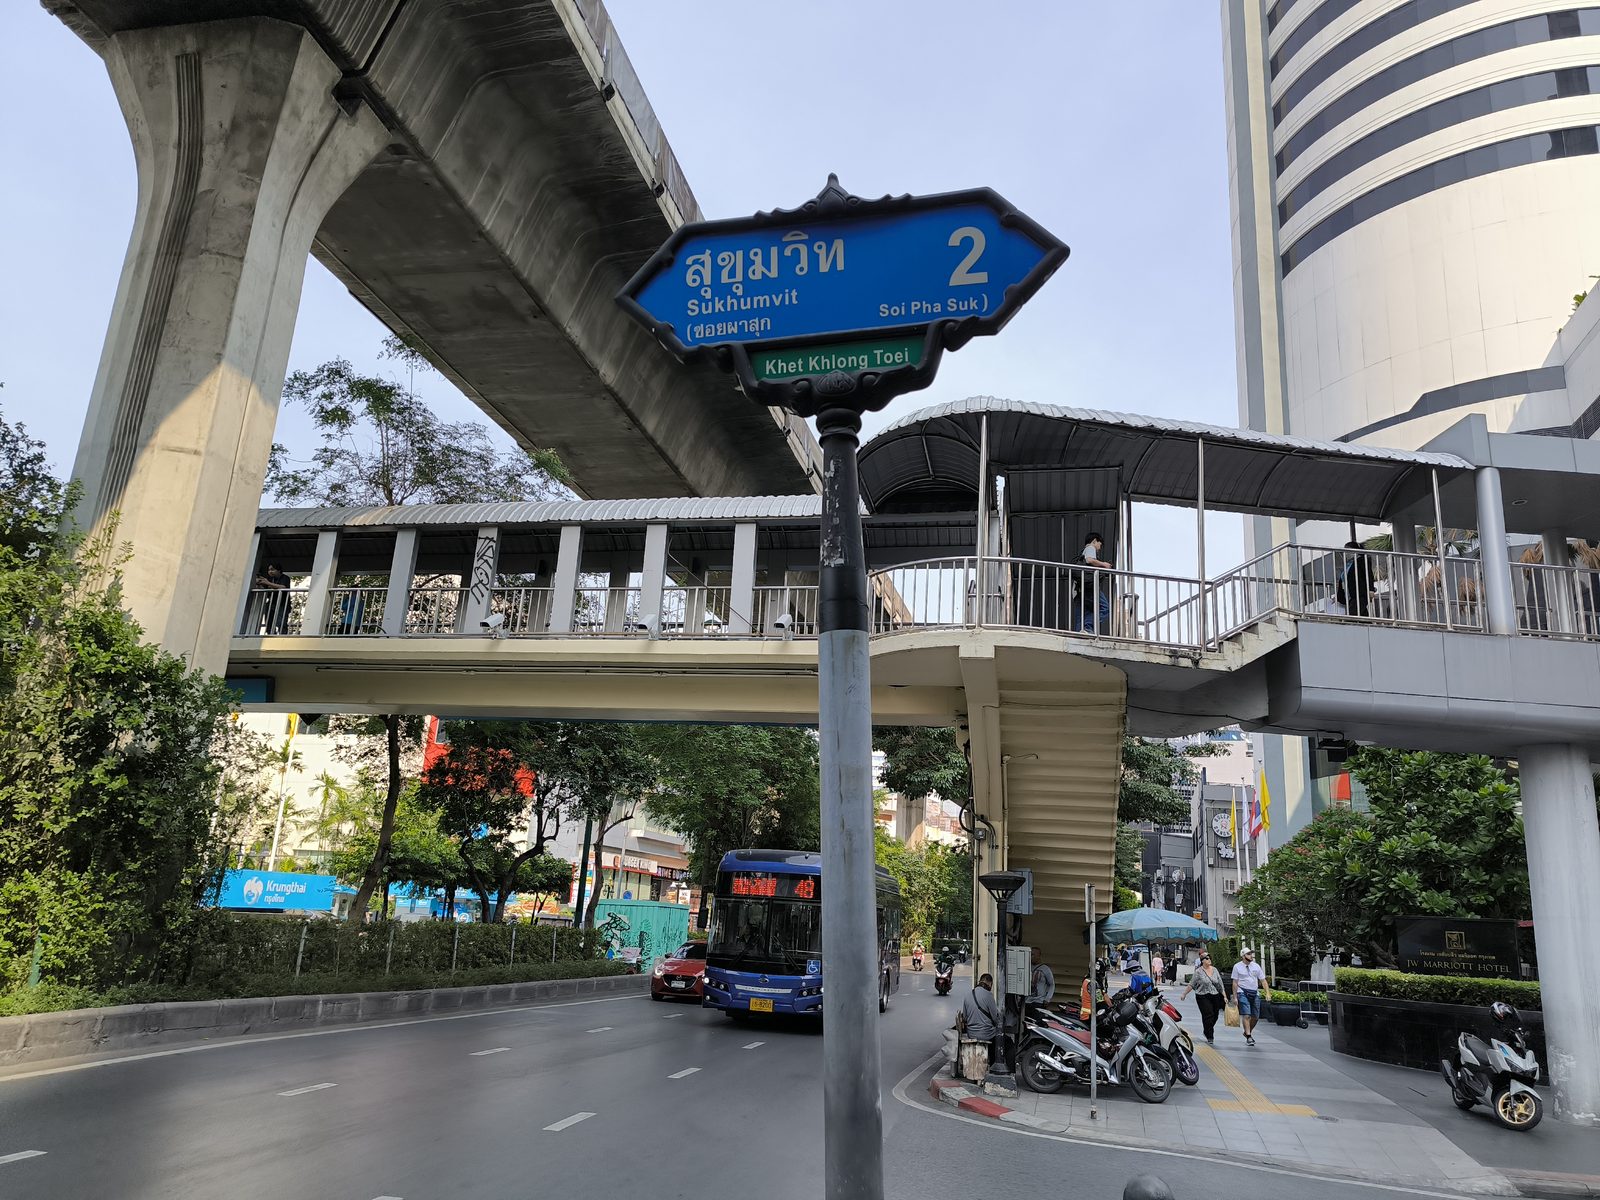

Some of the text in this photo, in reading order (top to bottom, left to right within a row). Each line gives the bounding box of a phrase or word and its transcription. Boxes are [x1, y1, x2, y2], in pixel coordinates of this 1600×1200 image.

[685, 231, 846, 299] สุขุมวิท
[947, 226, 989, 286] 2
[687, 288, 799, 317] Sukhumvit
[879, 302, 907, 318] Soi
[911, 298, 941, 316] Pha
[765, 348, 910, 376] Khet Khlong Toei
[264, 894, 285, 904] กรุงไทย
[266, 880, 307, 895] Krungthai
[1407, 959, 1512, 973] JW MARRIOTT HOTEL
